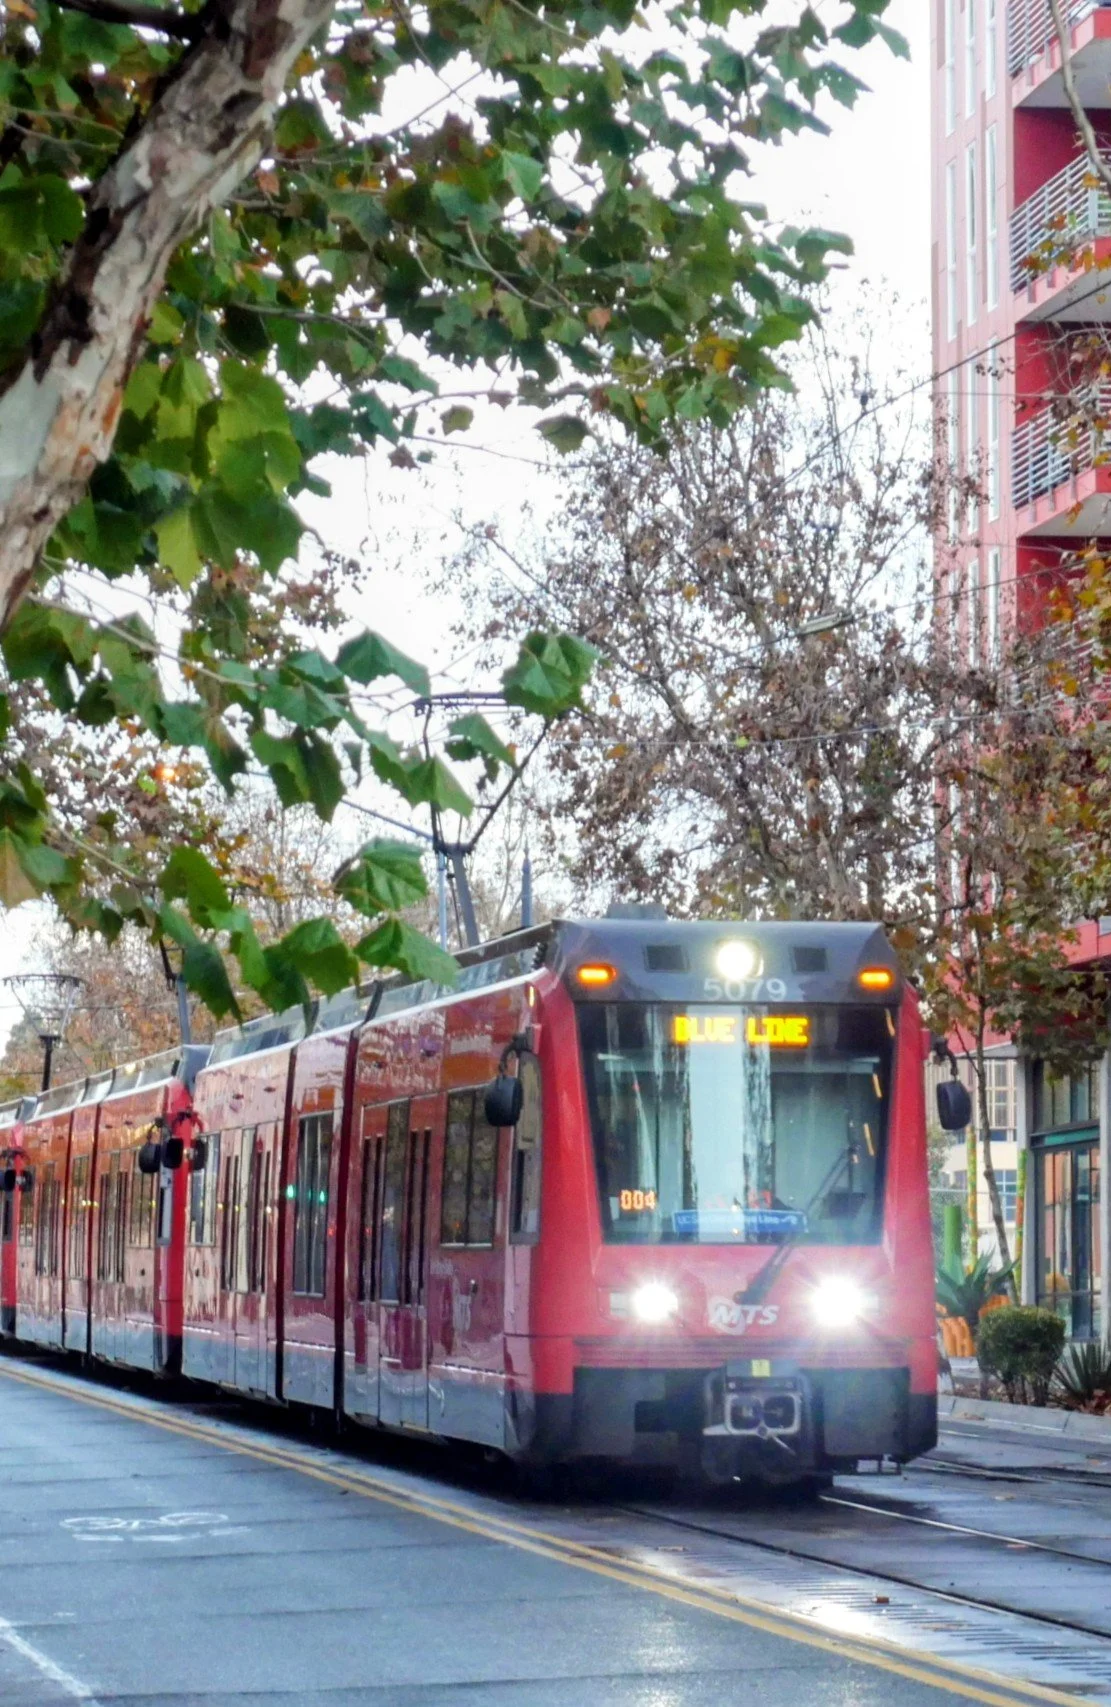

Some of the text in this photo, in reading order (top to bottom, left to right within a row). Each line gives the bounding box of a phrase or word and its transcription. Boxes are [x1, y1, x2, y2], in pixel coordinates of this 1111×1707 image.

[704, 978, 788, 1002] 5079
[674, 1015, 809, 1045] BLUE LINE
[620, 1189, 656, 1211] 004
[709, 1302, 781, 1328] MTS
